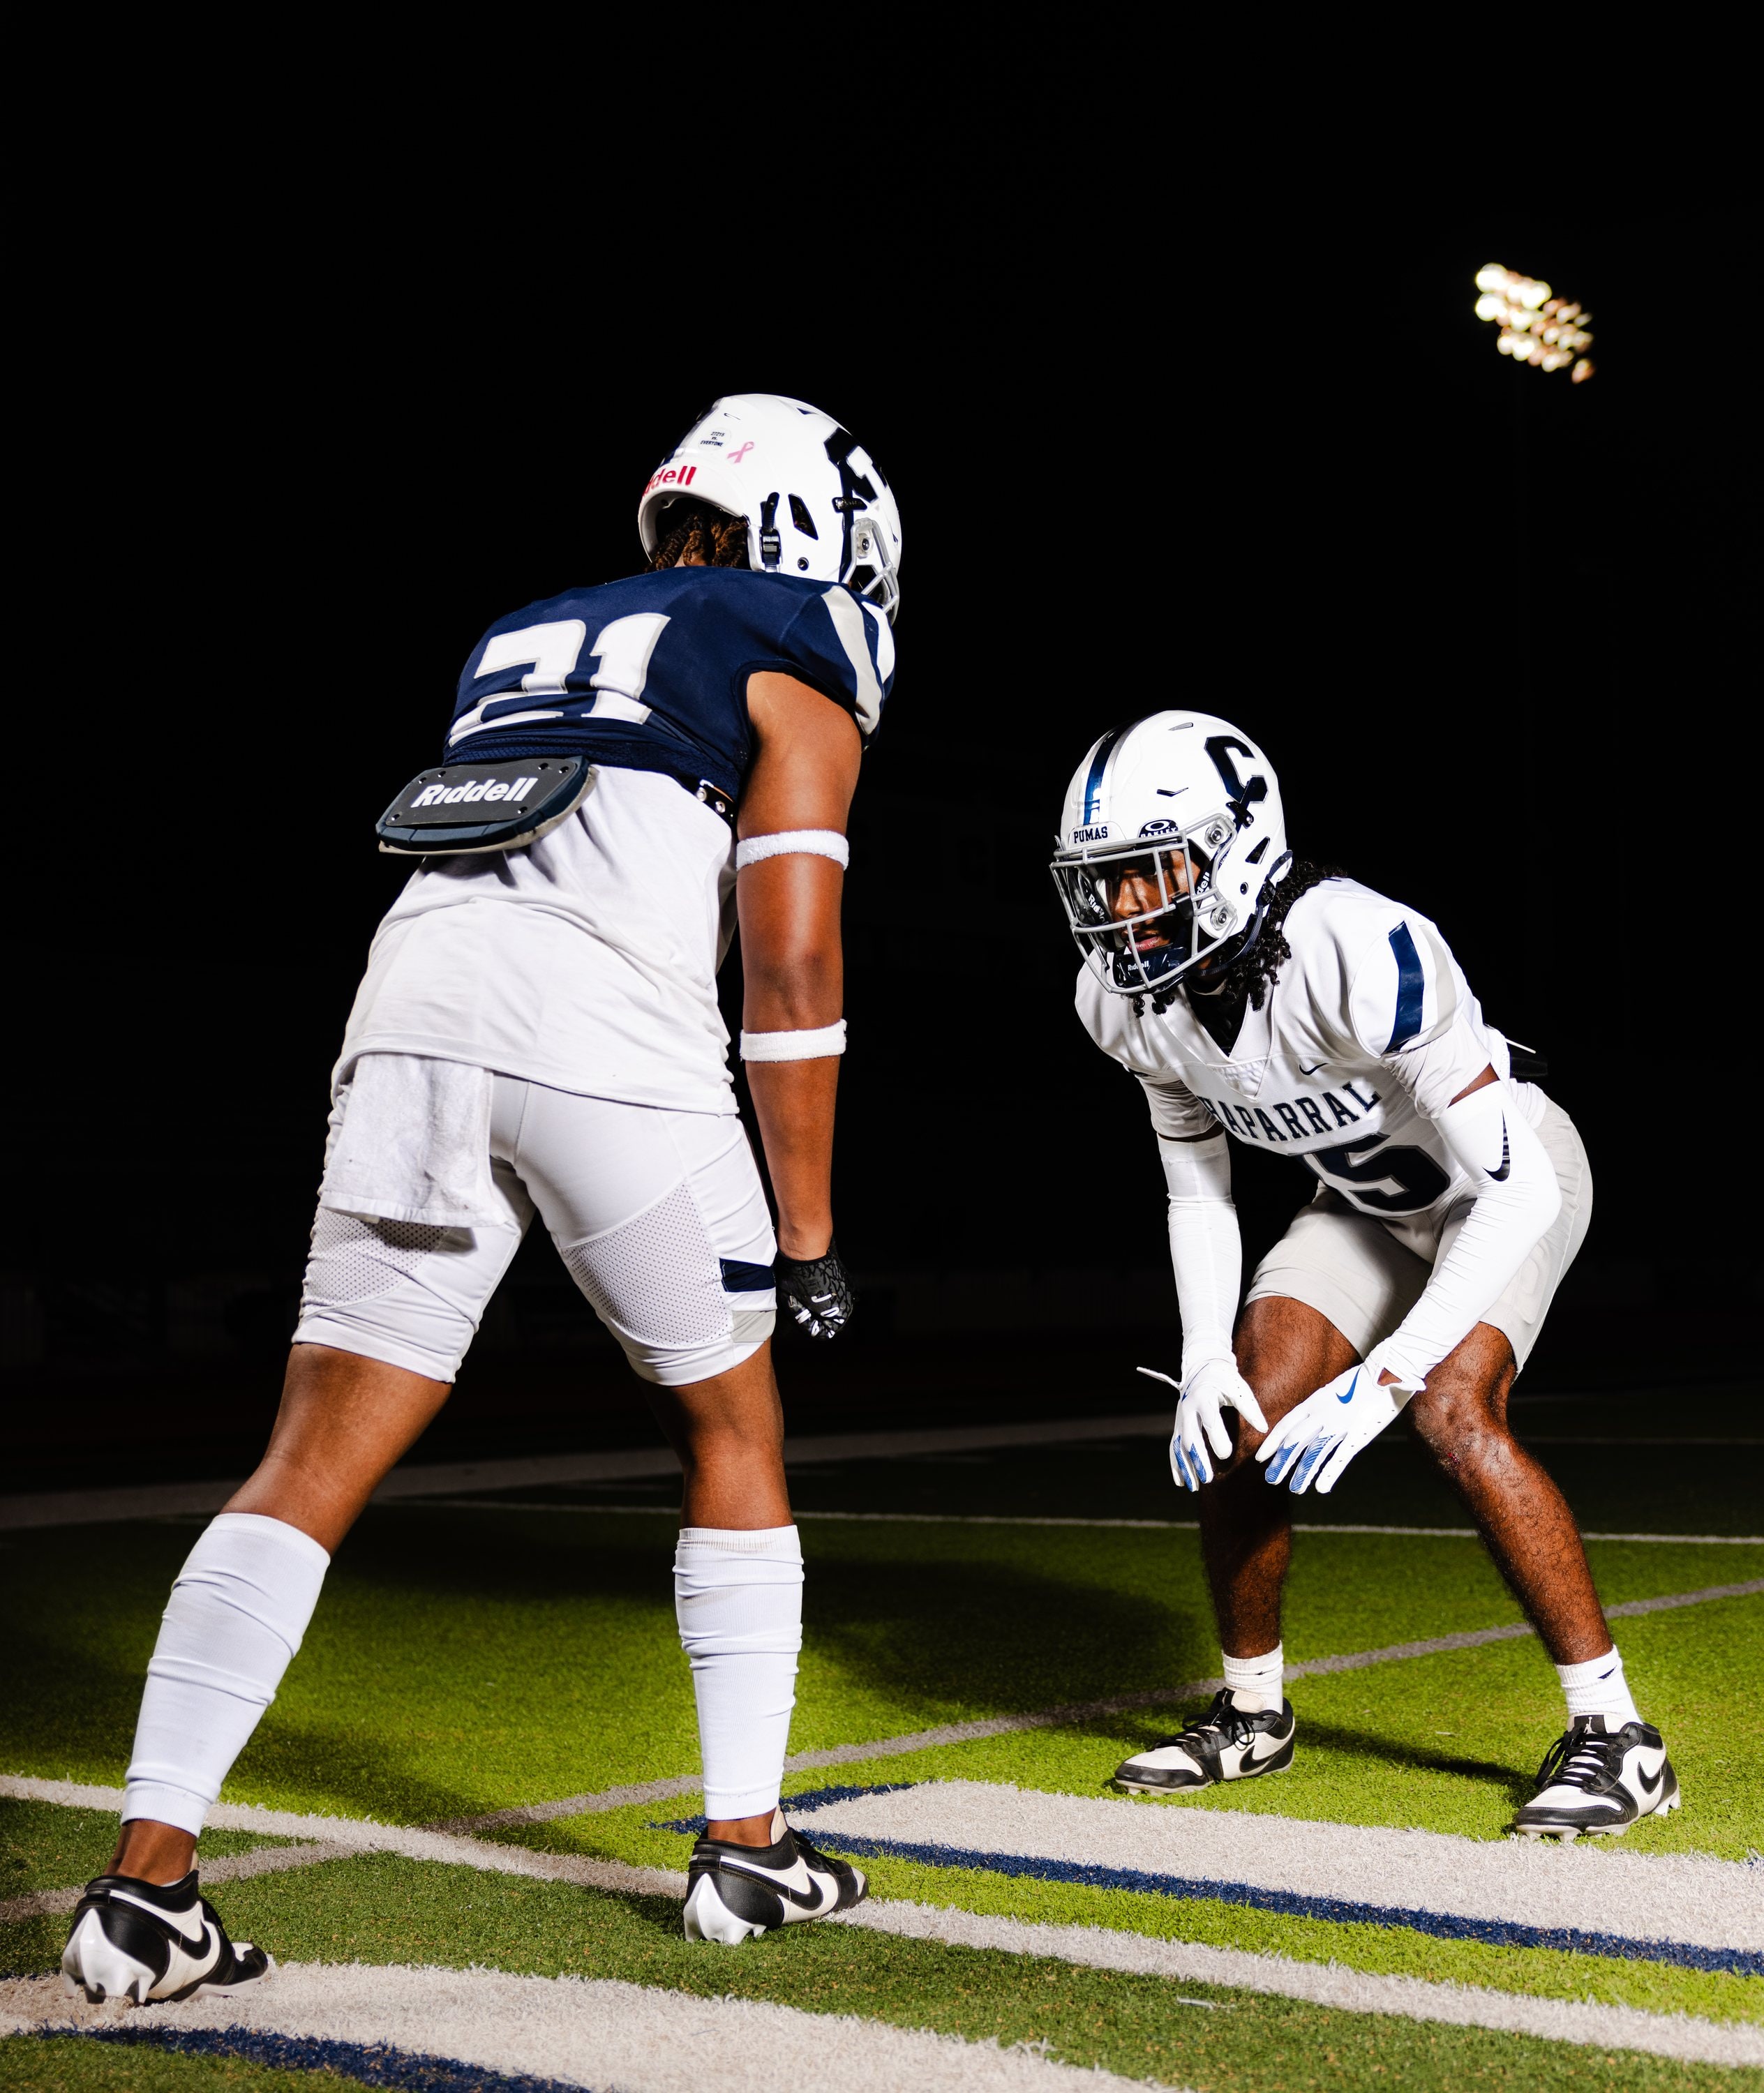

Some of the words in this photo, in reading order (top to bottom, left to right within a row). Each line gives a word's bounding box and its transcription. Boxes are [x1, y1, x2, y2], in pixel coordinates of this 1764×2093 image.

[642, 465, 697, 496] dell
[448, 613, 671, 747] 21
[1204, 735, 1269, 804] C
[410, 777, 538, 808] Riddell
[1073, 826, 1108, 844] PUMAS
[1140, 827, 1177, 838] OAKLEY
[1197, 871, 1211, 895] dell
[1128, 960, 1149, 971] Ridll
